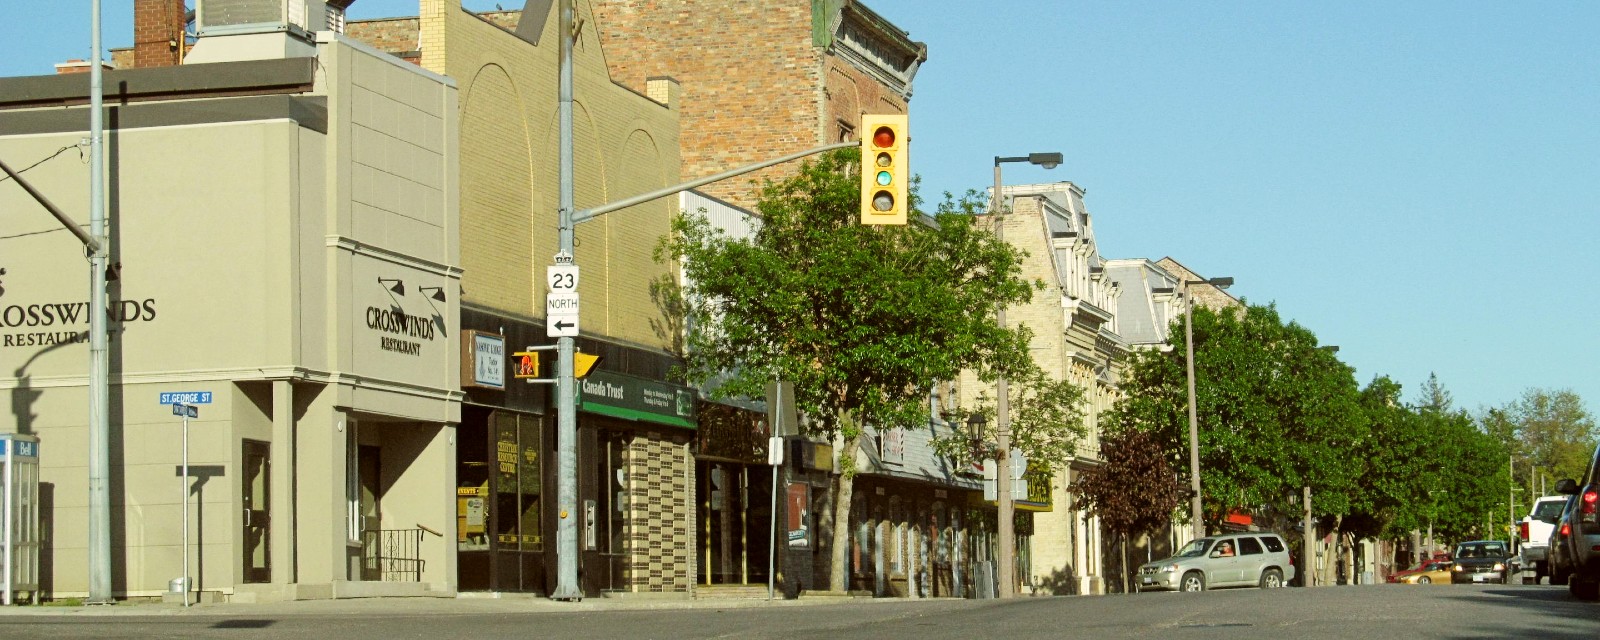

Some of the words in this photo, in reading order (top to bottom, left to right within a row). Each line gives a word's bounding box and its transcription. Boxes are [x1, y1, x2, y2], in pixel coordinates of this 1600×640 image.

[552, 273, 574, 289] 23
[0, 298, 156, 328] OSSWINDS
[548, 299, 578, 309] NORTH
[366, 306, 435, 341] CROSSWINDS
[3, 329, 117, 347] RESTAURAT
[381, 336, 421, 356] RESTAURANT
[201, 392, 211, 402] ST
[582, 378, 606, 397] Canada
[606, 382, 624, 400] Trust
[20, 441, 31, 456] Bell
